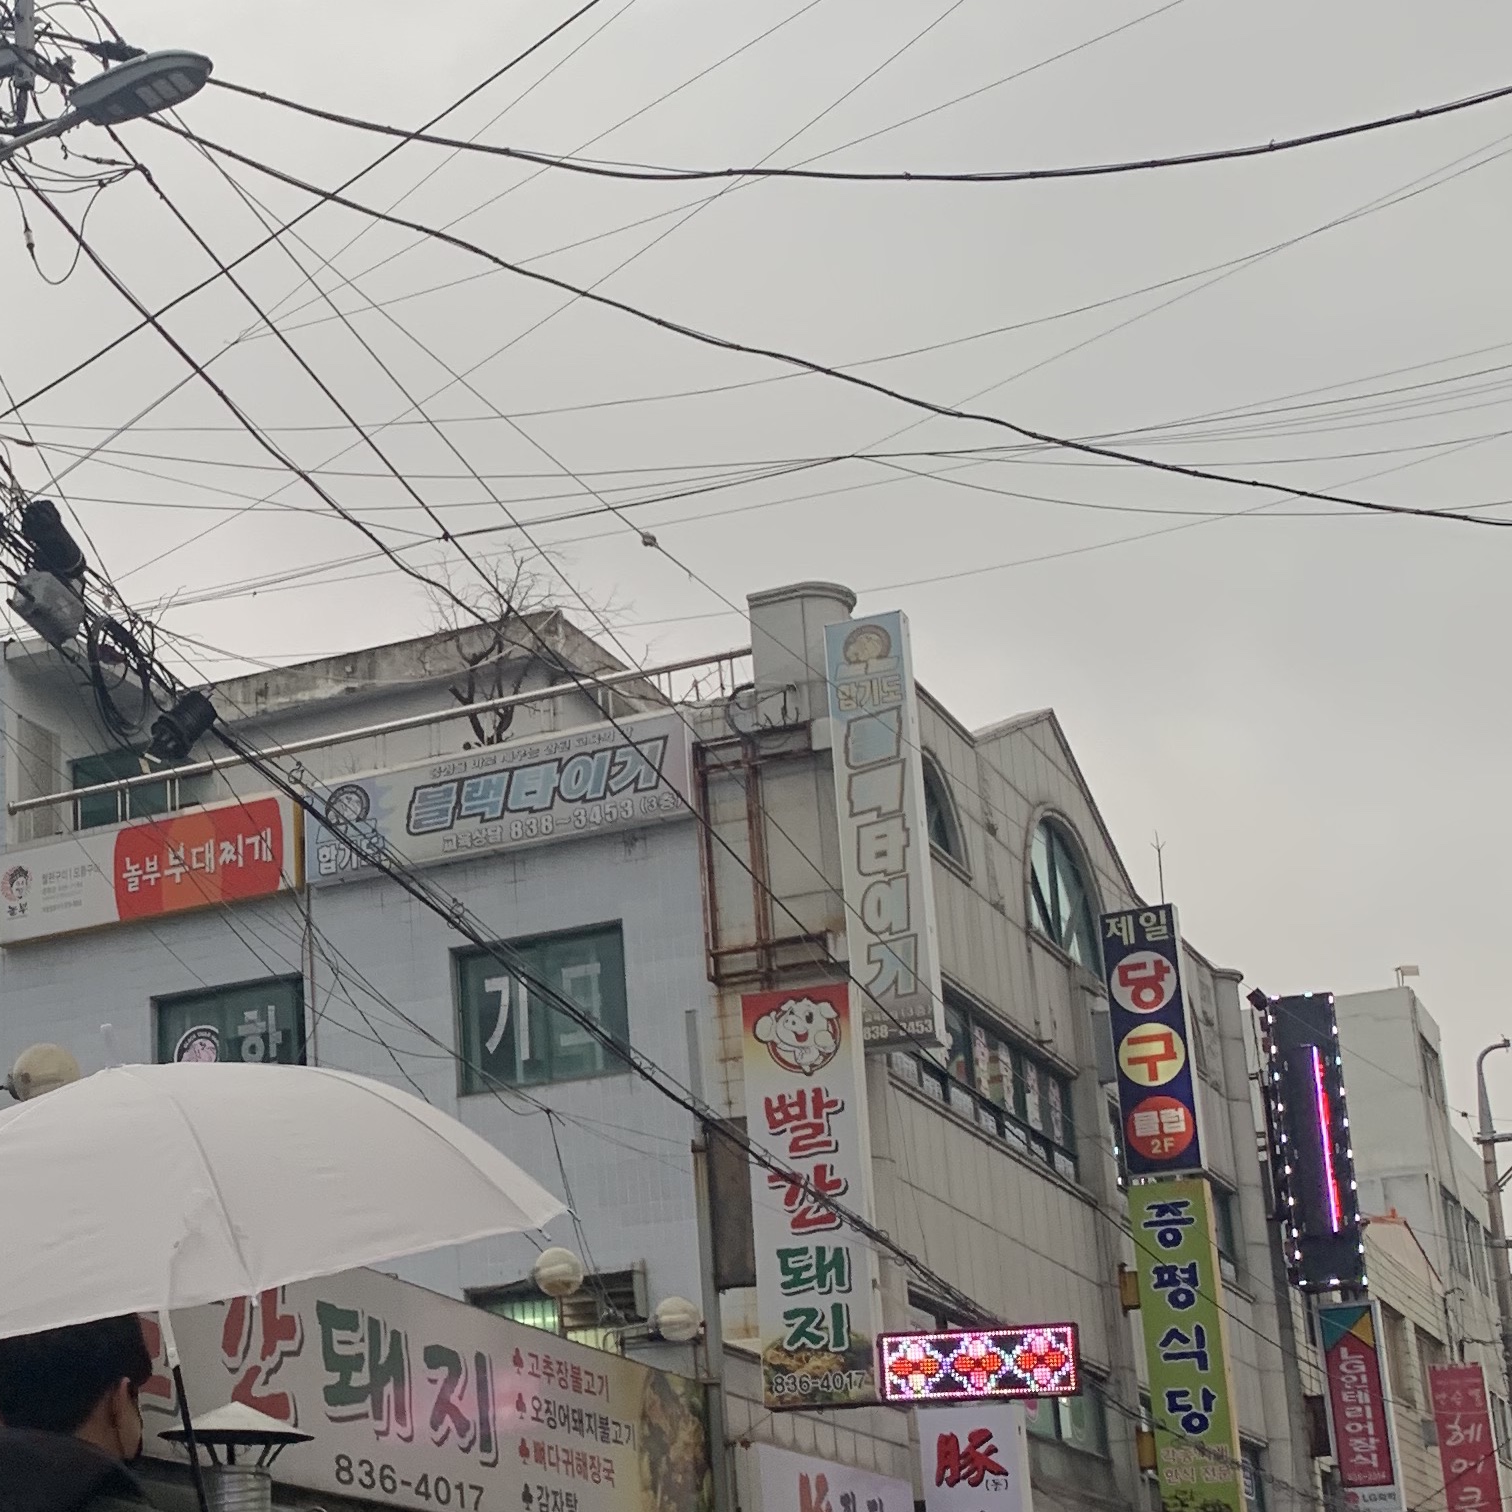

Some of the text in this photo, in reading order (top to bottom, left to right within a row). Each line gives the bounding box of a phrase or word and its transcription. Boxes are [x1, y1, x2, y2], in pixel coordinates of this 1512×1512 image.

[407, 735, 669, 835] 블랙타이거
[122, 827, 274, 893] 놀부 부대찌개
[1106, 910, 1171, 946] 제일
[1118, 959, 1178, 1082] 당구
[1134, 1107, 1187, 1138] 클럽
[1150, 1138, 1175, 1154] 2F
[764, 1086, 853, 1355] 빨간돼지
[1142, 1199, 1217, 1436] 증평식당
[528, 1352, 610, 1402] 고추장불고기
[772, 1370, 867, 1395] 836-4017
[531, 1396, 637, 1451] 오징어돼지불고기
[335, 1454, 485, 1512] 836-4017
[533, 1440, 616, 1489] 뼈다귀해장국
